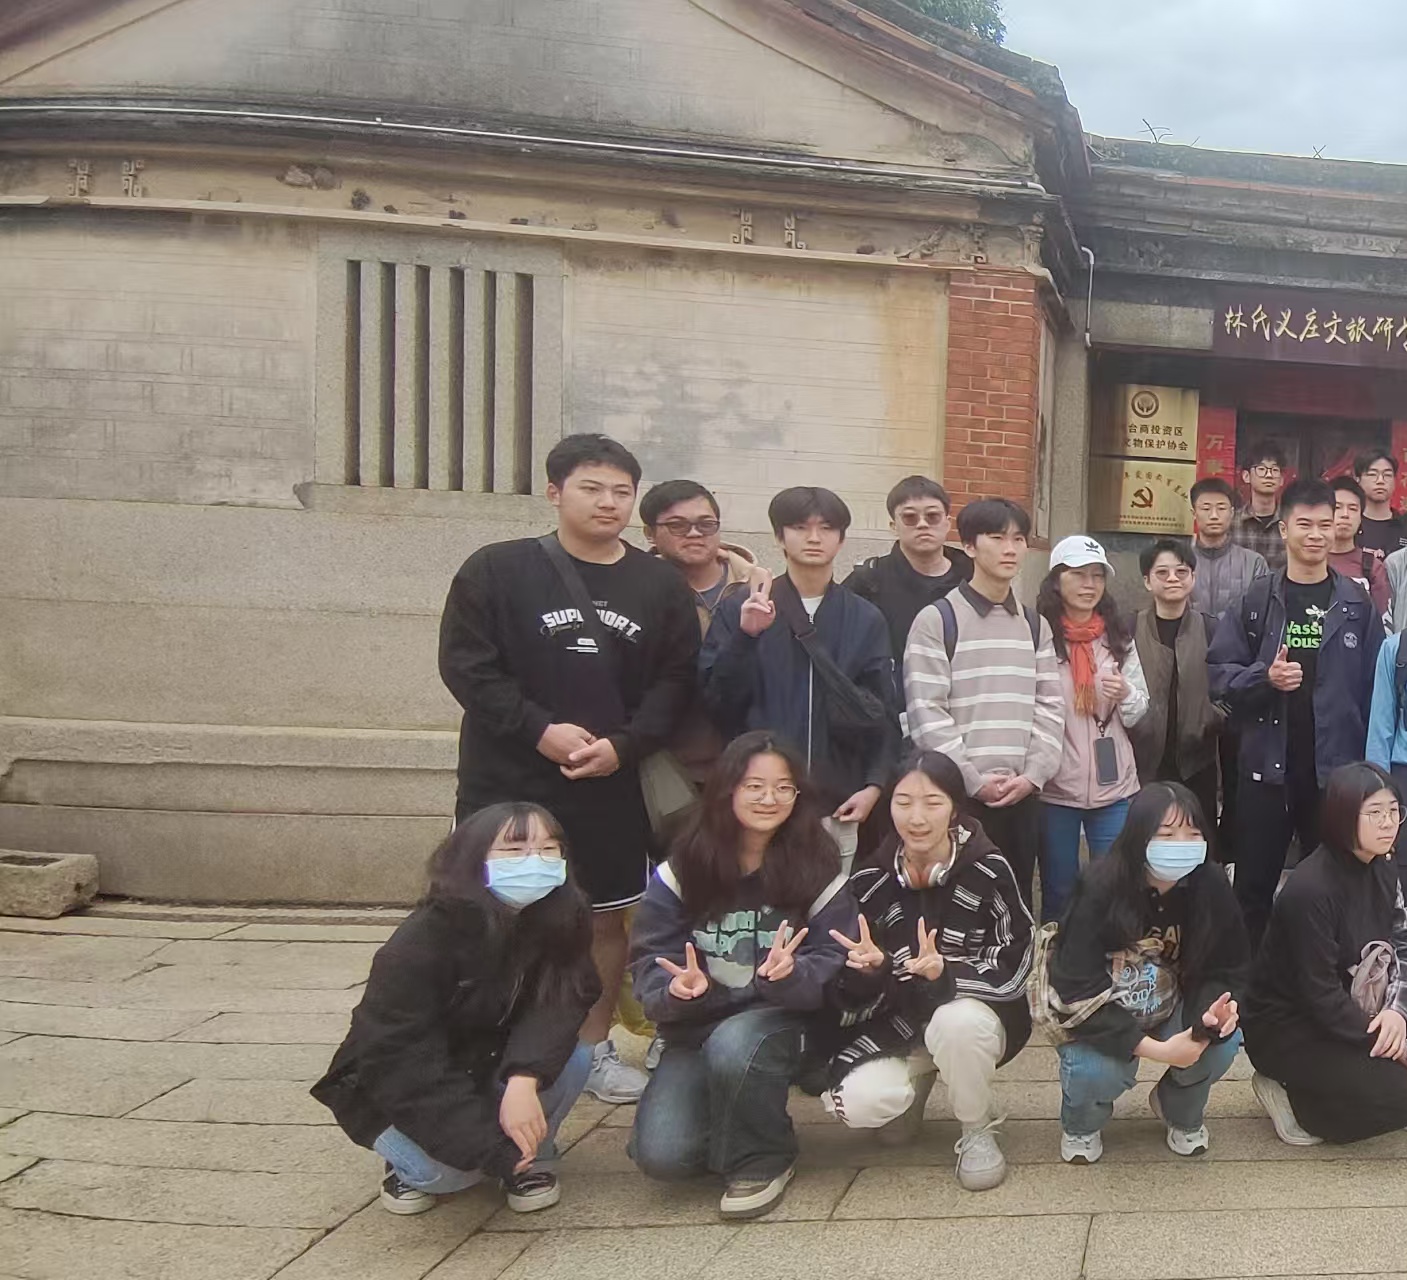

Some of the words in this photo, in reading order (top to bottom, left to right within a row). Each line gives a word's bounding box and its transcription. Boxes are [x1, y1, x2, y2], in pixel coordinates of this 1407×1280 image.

[1128, 423, 1184, 437] 台商投资区
